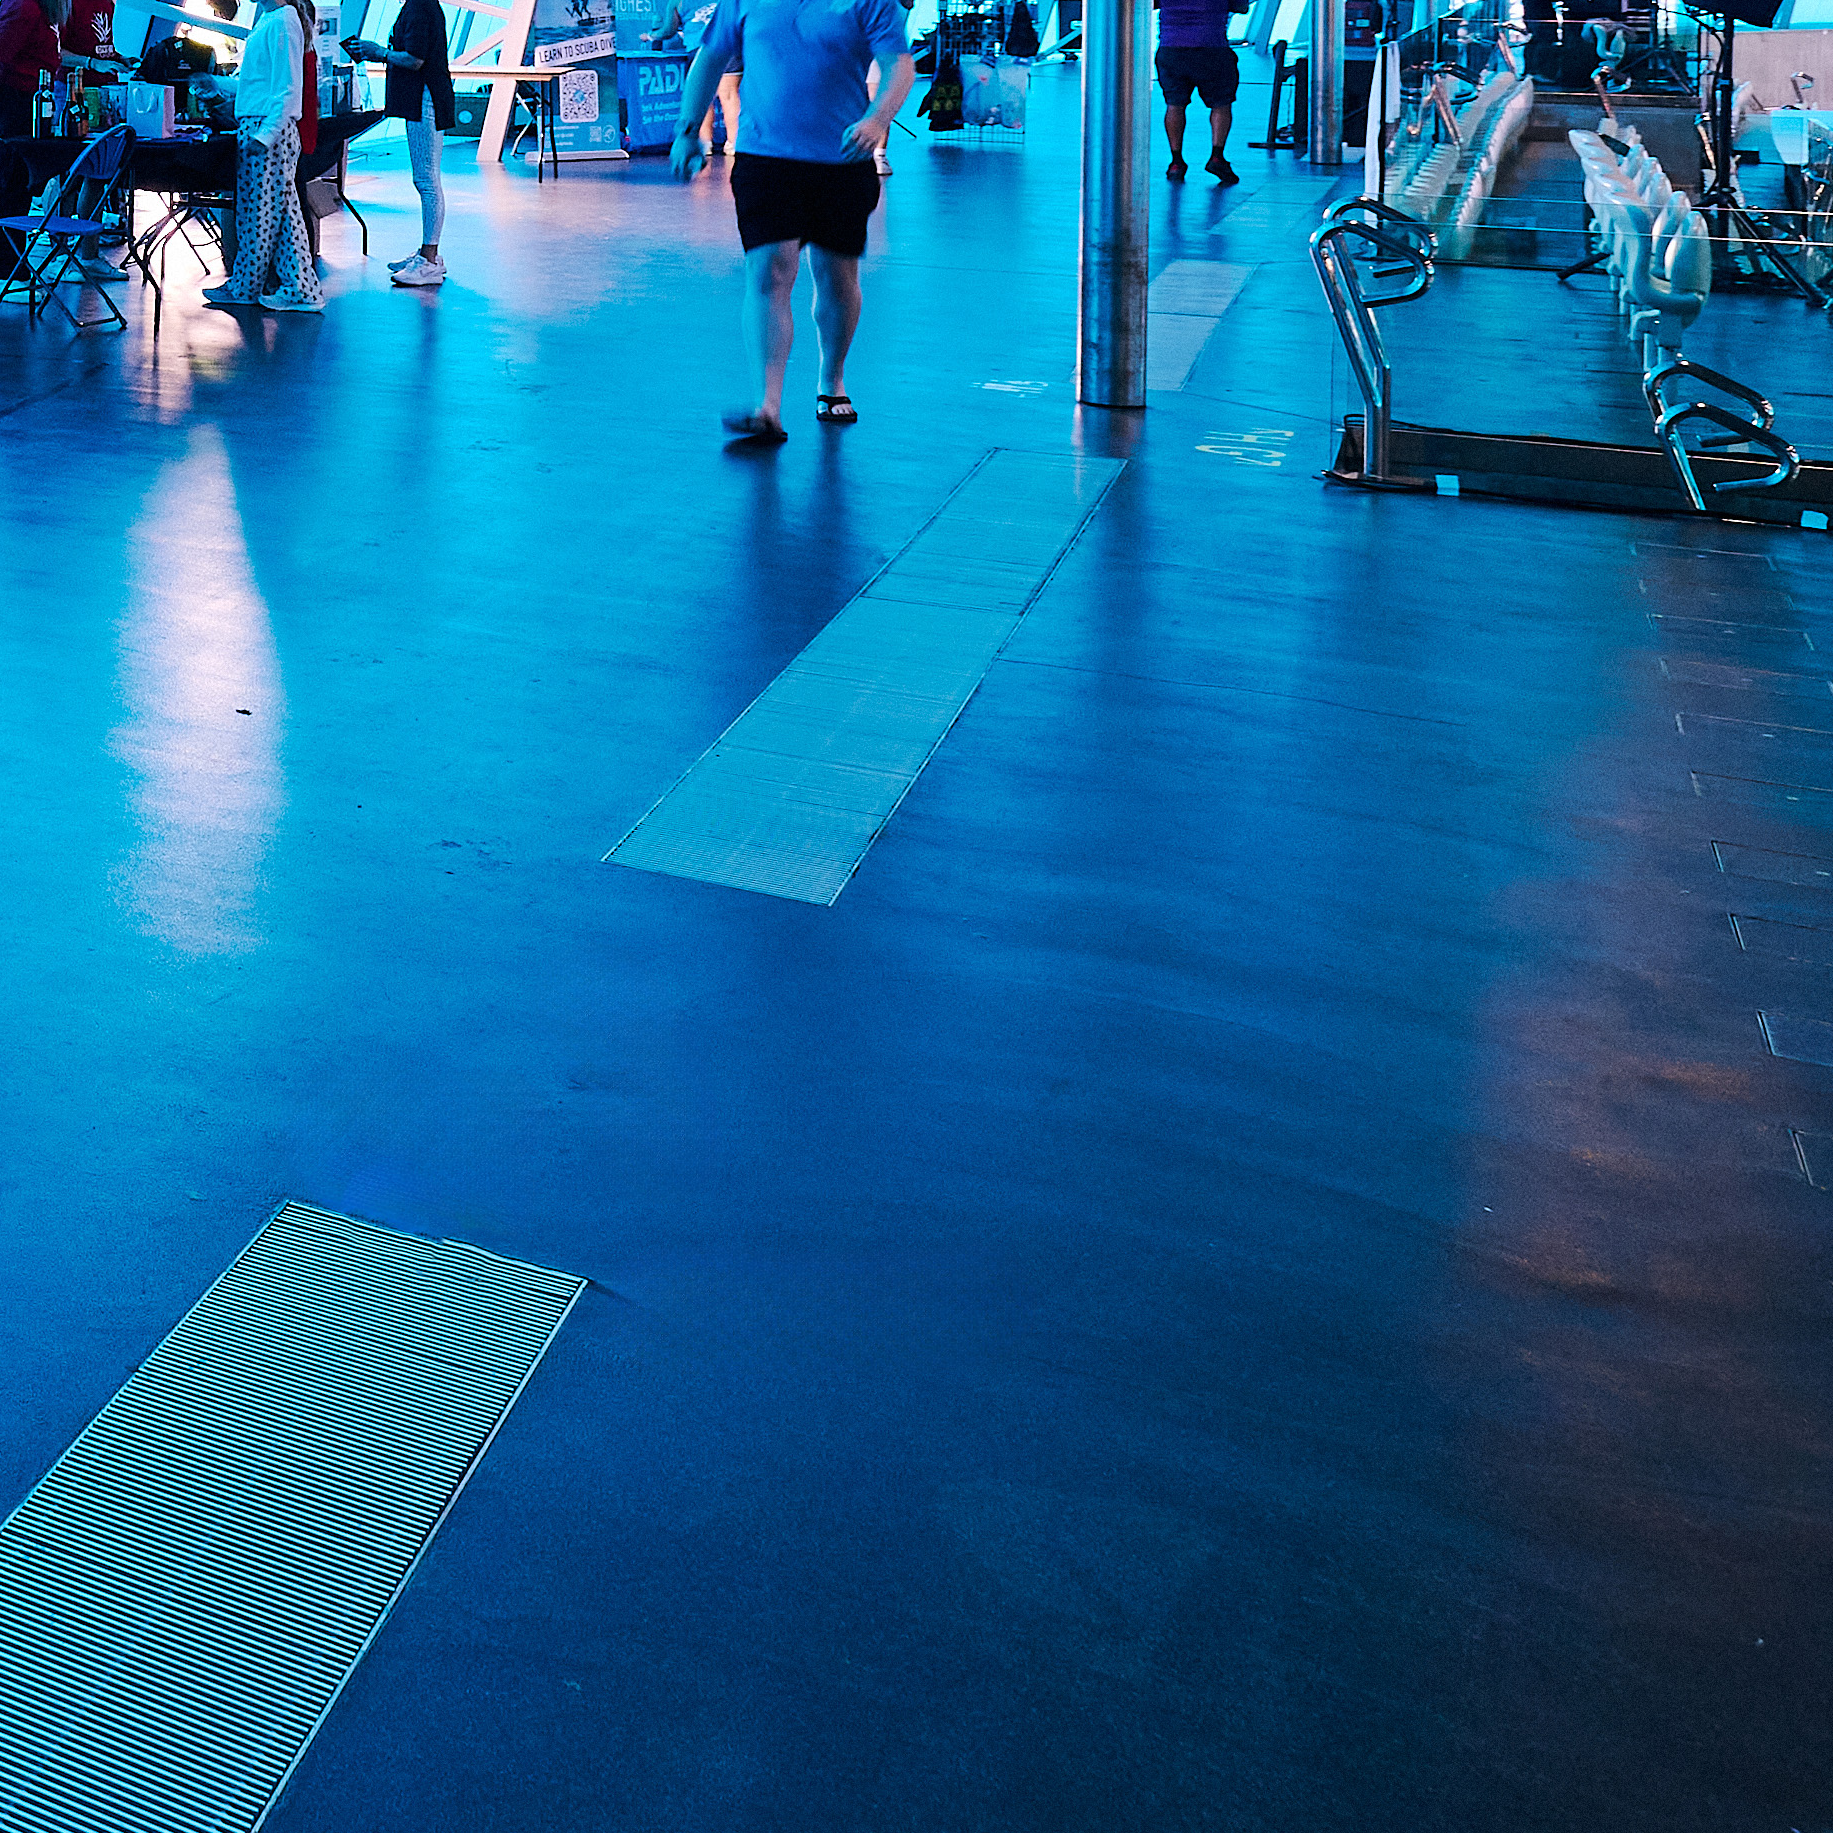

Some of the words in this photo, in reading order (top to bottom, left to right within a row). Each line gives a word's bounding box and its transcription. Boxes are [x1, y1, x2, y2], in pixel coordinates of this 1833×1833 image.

[538, 46, 563, 64] LEARN
[564, 46, 573, 58] TO
[574, 42, 600, 57] SCUBA
[600, 36, 616, 52] DIVE
[638, 63, 685, 97] PADI
